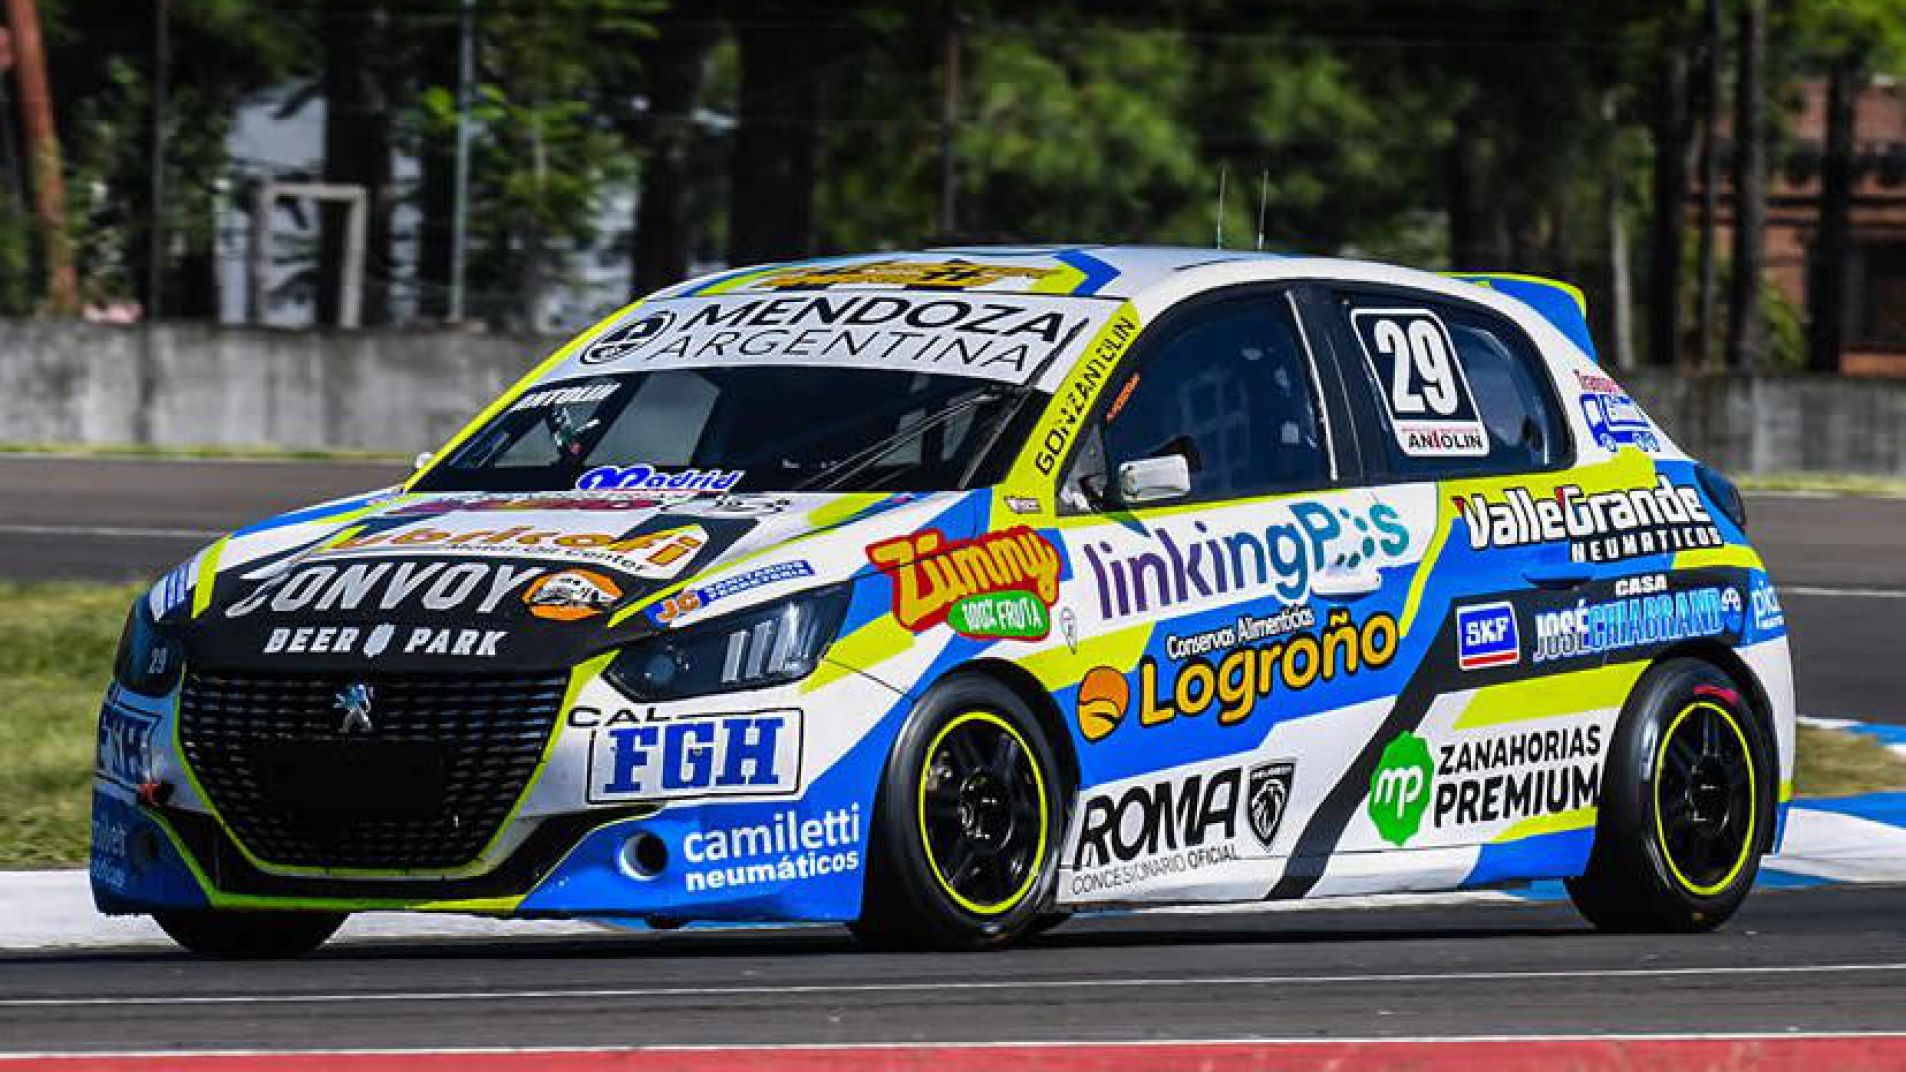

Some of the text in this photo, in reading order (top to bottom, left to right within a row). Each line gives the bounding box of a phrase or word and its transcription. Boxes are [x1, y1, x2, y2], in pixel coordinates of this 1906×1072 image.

[677, 296, 1065, 342] MENDOZA
[646, 329, 1029, 372] ARGENTINA
[1374, 319, 1458, 415] 29
[577, 465, 745, 491] Madrid
[1452, 474, 1713, 549] ValleGrande
[225, 556, 550, 618] CONVOY
[1615, 574, 1668, 597] CASA
[263, 627, 508, 656] BEER PARK
[1166, 627, 1235, 660] Conservas
[1464, 617, 1510, 647] SKF
[1138, 608, 1400, 726] Logroño
[567, 706, 672, 727] CAL
[603, 716, 785, 794] FGH
[1438, 725, 1601, 776] ZANAHORIAS
[1072, 766, 1243, 871] ROMA
[1434, 763, 1601, 829] PREMIUM
[683, 802, 861, 864] camiletti
[685, 850, 859, 893] neumáticos
[1072, 845, 1237, 895] CONCESIONARIO OFICIAL
